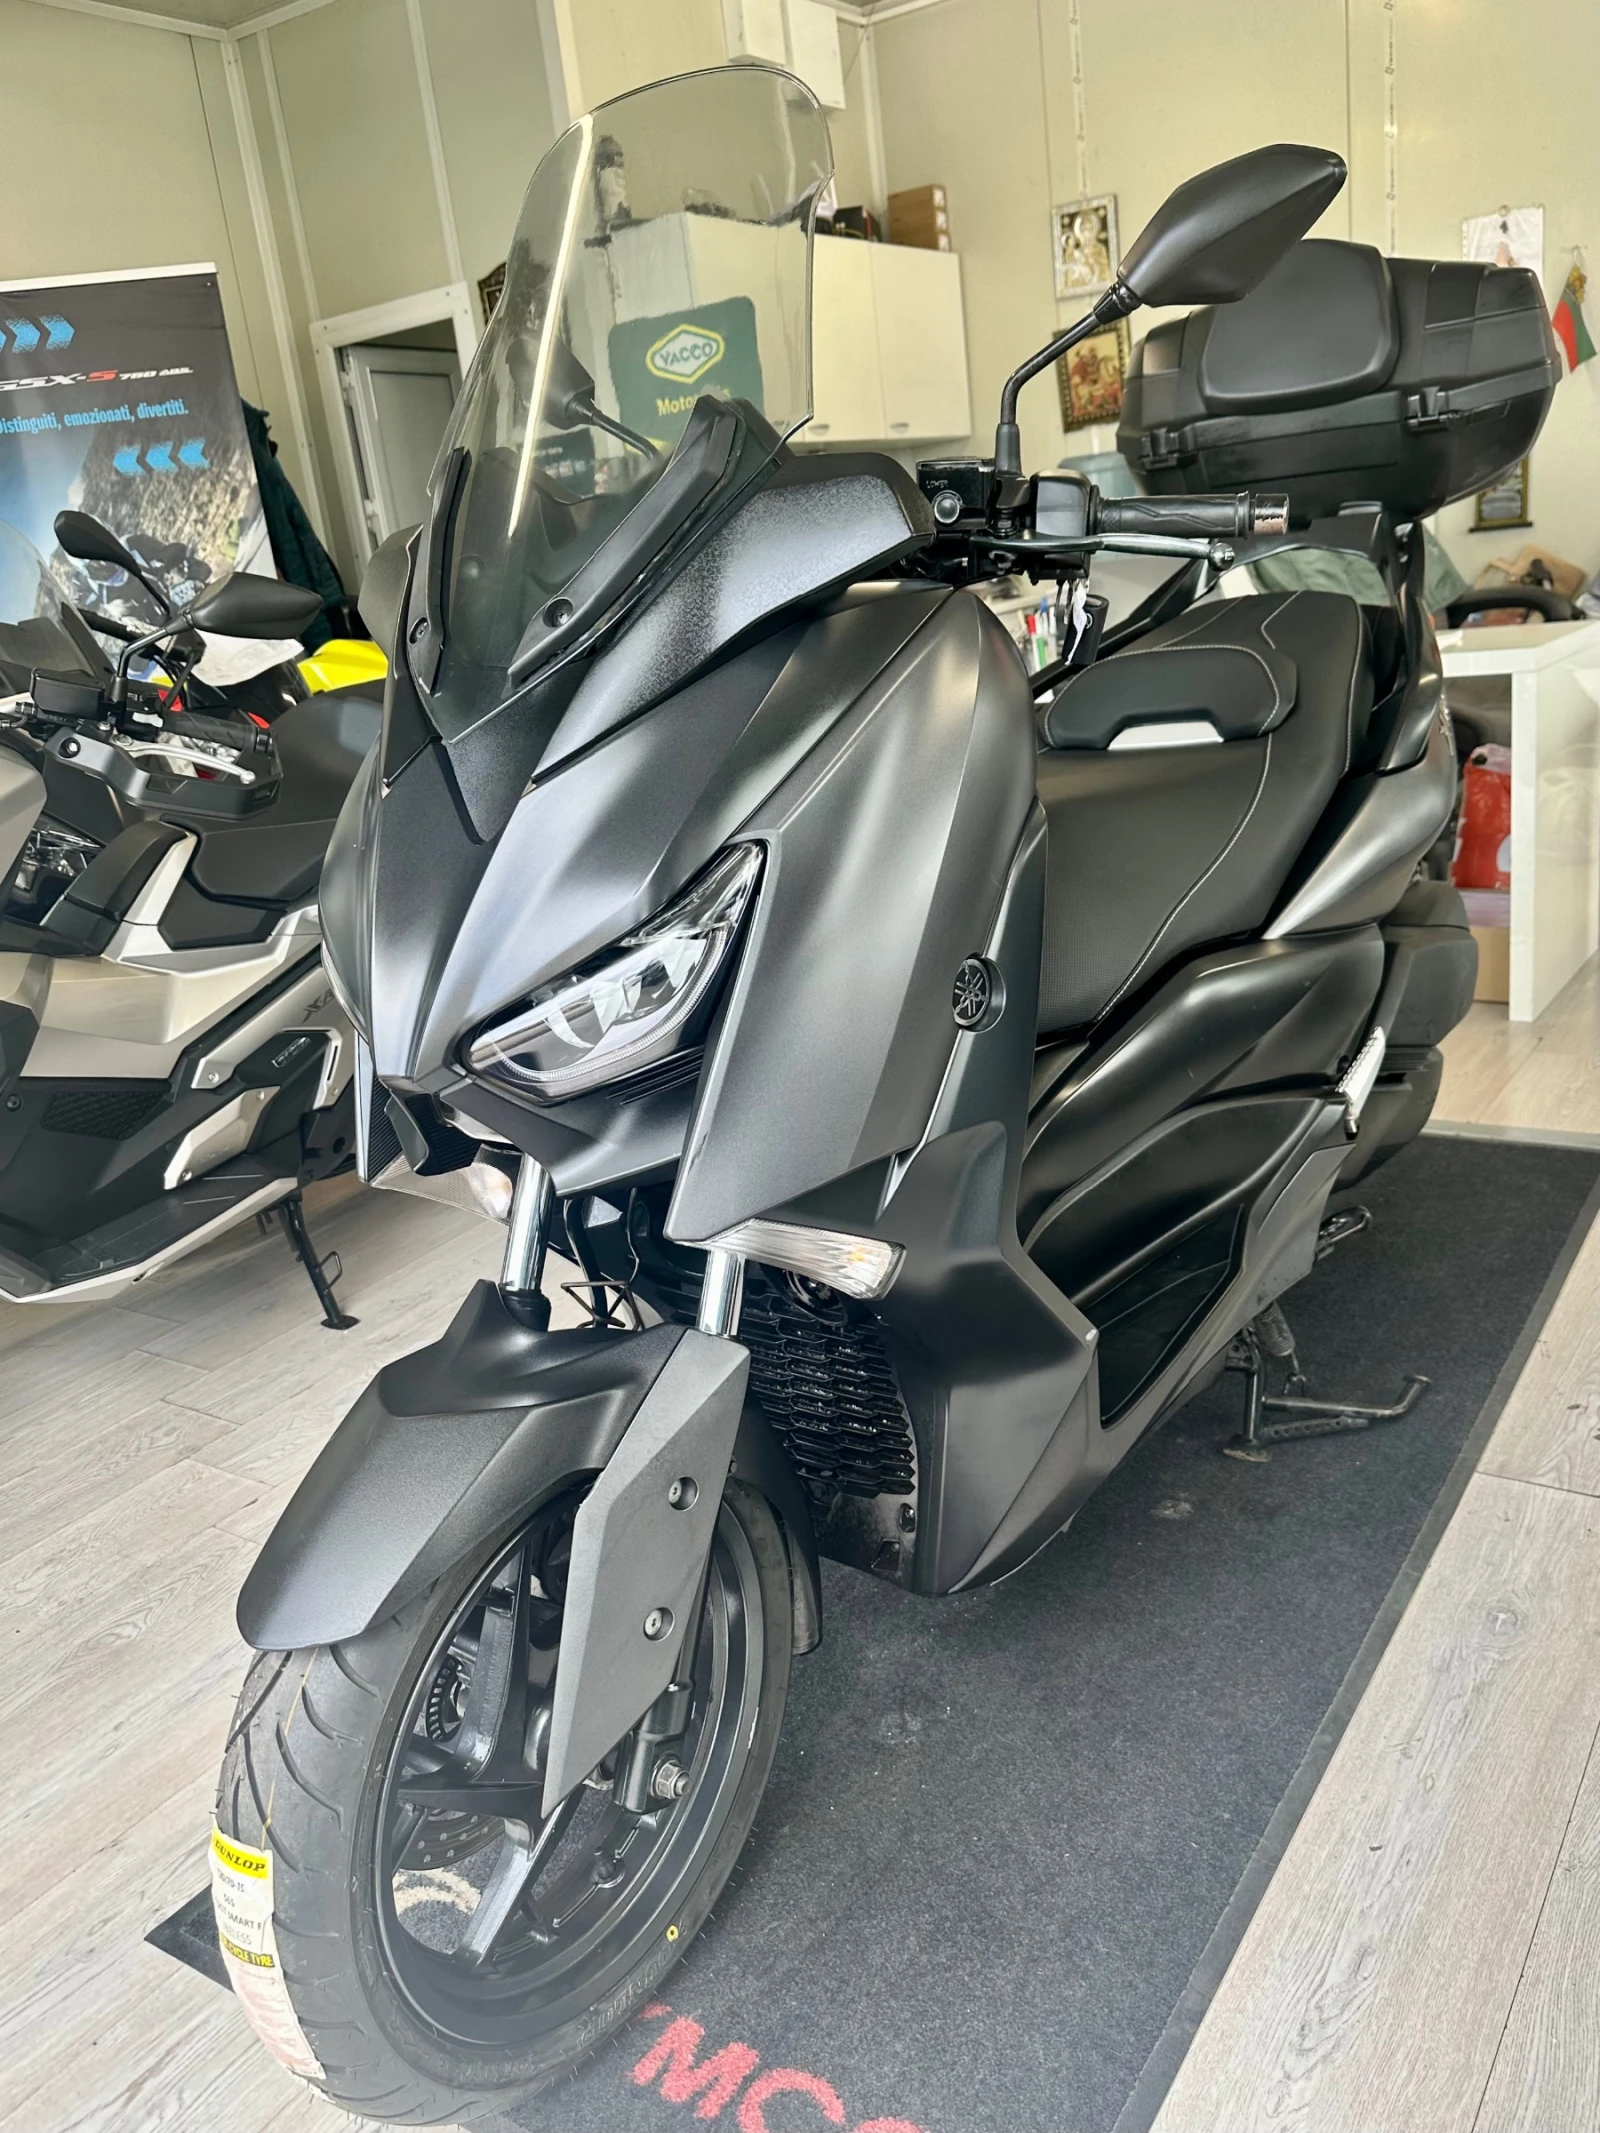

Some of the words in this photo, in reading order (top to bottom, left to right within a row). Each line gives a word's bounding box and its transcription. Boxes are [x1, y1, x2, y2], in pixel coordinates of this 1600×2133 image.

[659, 342, 713, 366] YACCO
[64, 405, 135, 428] emozionati,
[137, 398, 189, 419] divertiti.
[214, 1840, 265, 1873] DUNLOP
[250, 1953, 274, 1968] TYRE
